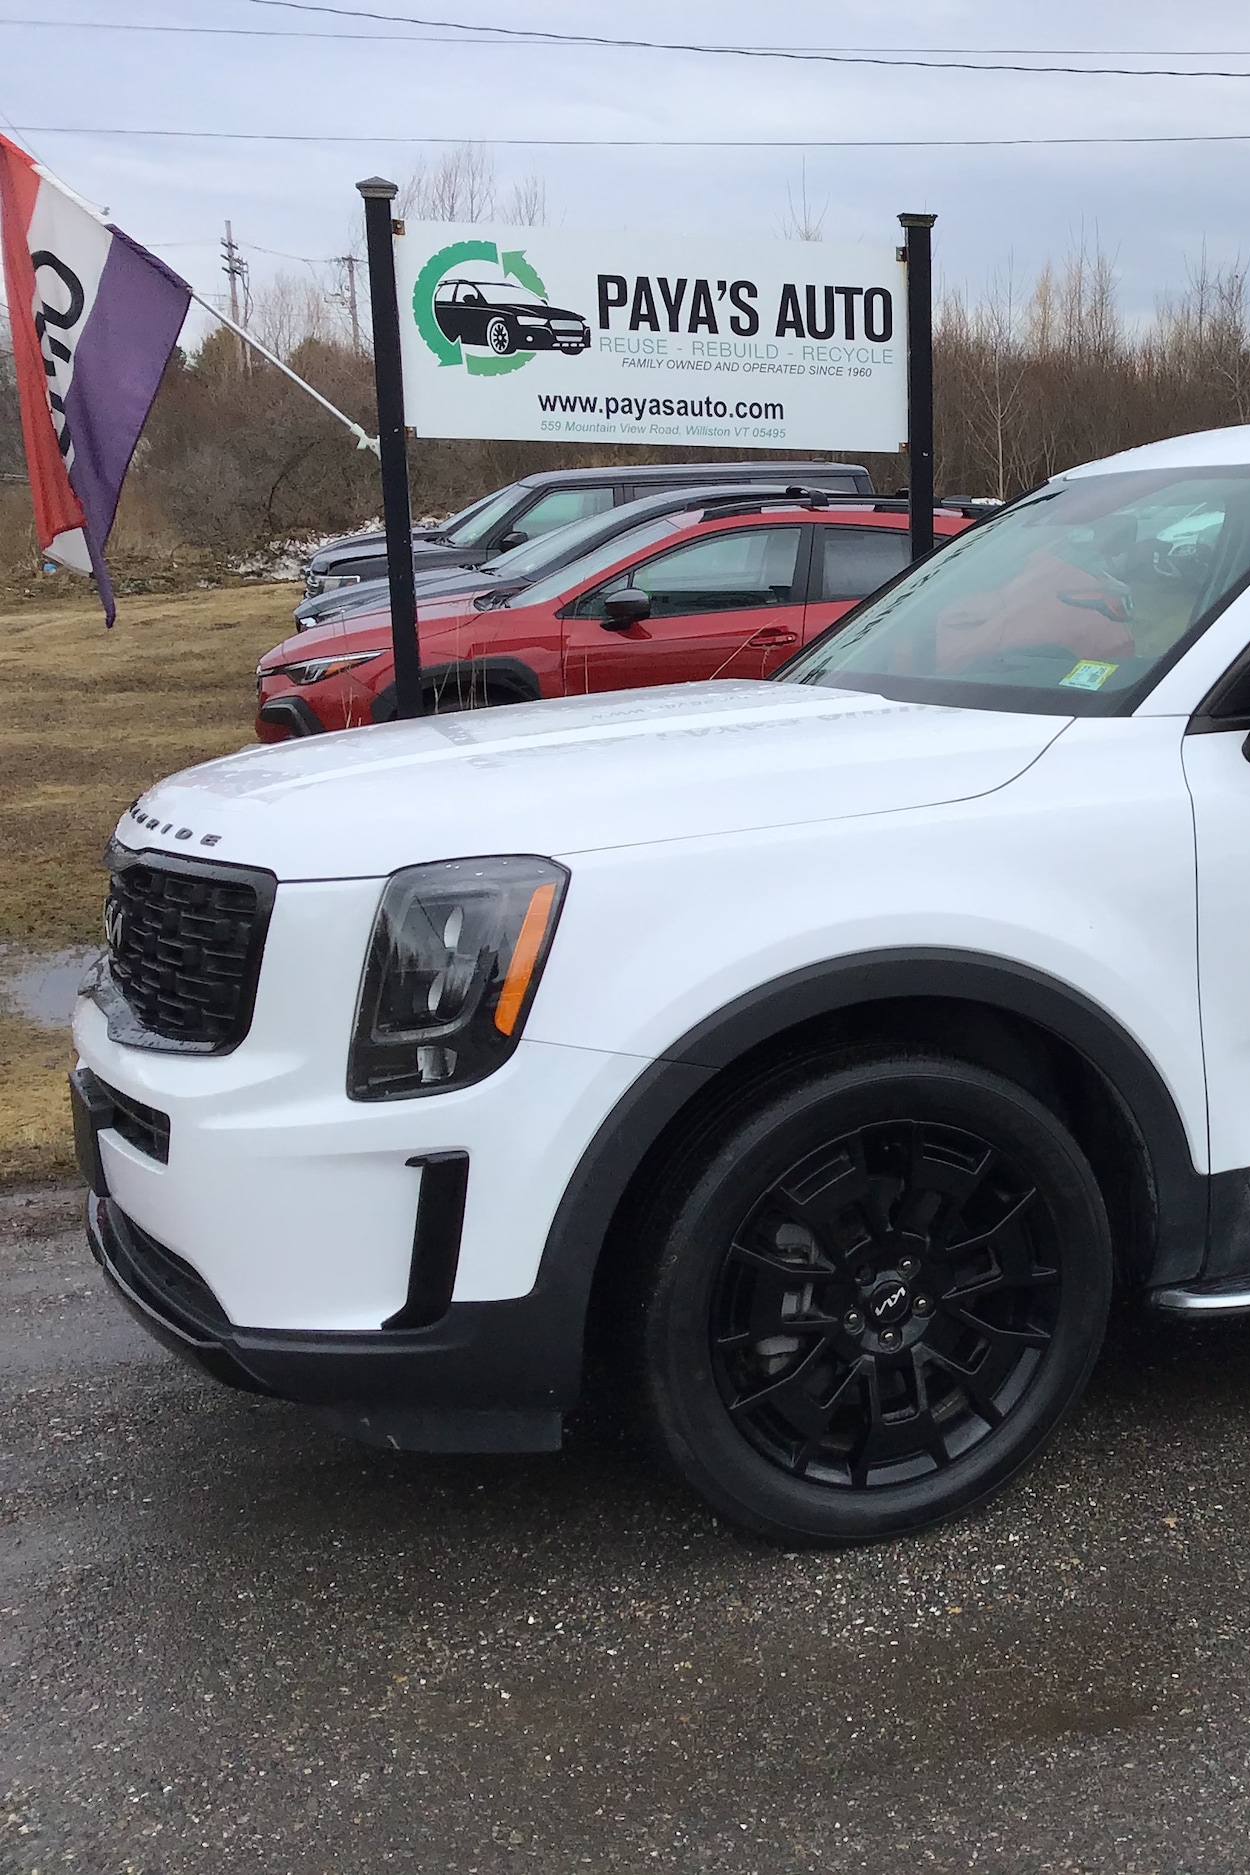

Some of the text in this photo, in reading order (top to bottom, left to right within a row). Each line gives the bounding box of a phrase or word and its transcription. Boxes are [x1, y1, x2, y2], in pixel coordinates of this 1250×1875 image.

[597, 274, 893, 343] PAYA'S AUTO
[599, 336, 668, 355] REUSE
[692, 340, 779, 359] REBUILD
[802, 345, 894, 365] RECYCLE
[621, 357, 872, 378] FAMILY OWNED AND OPERATED SINCE 1960
[537, 394, 784, 421] www.payasauto.com
[540, 420, 786, 439] 559 Mountain View Road, Williston VT 05495
